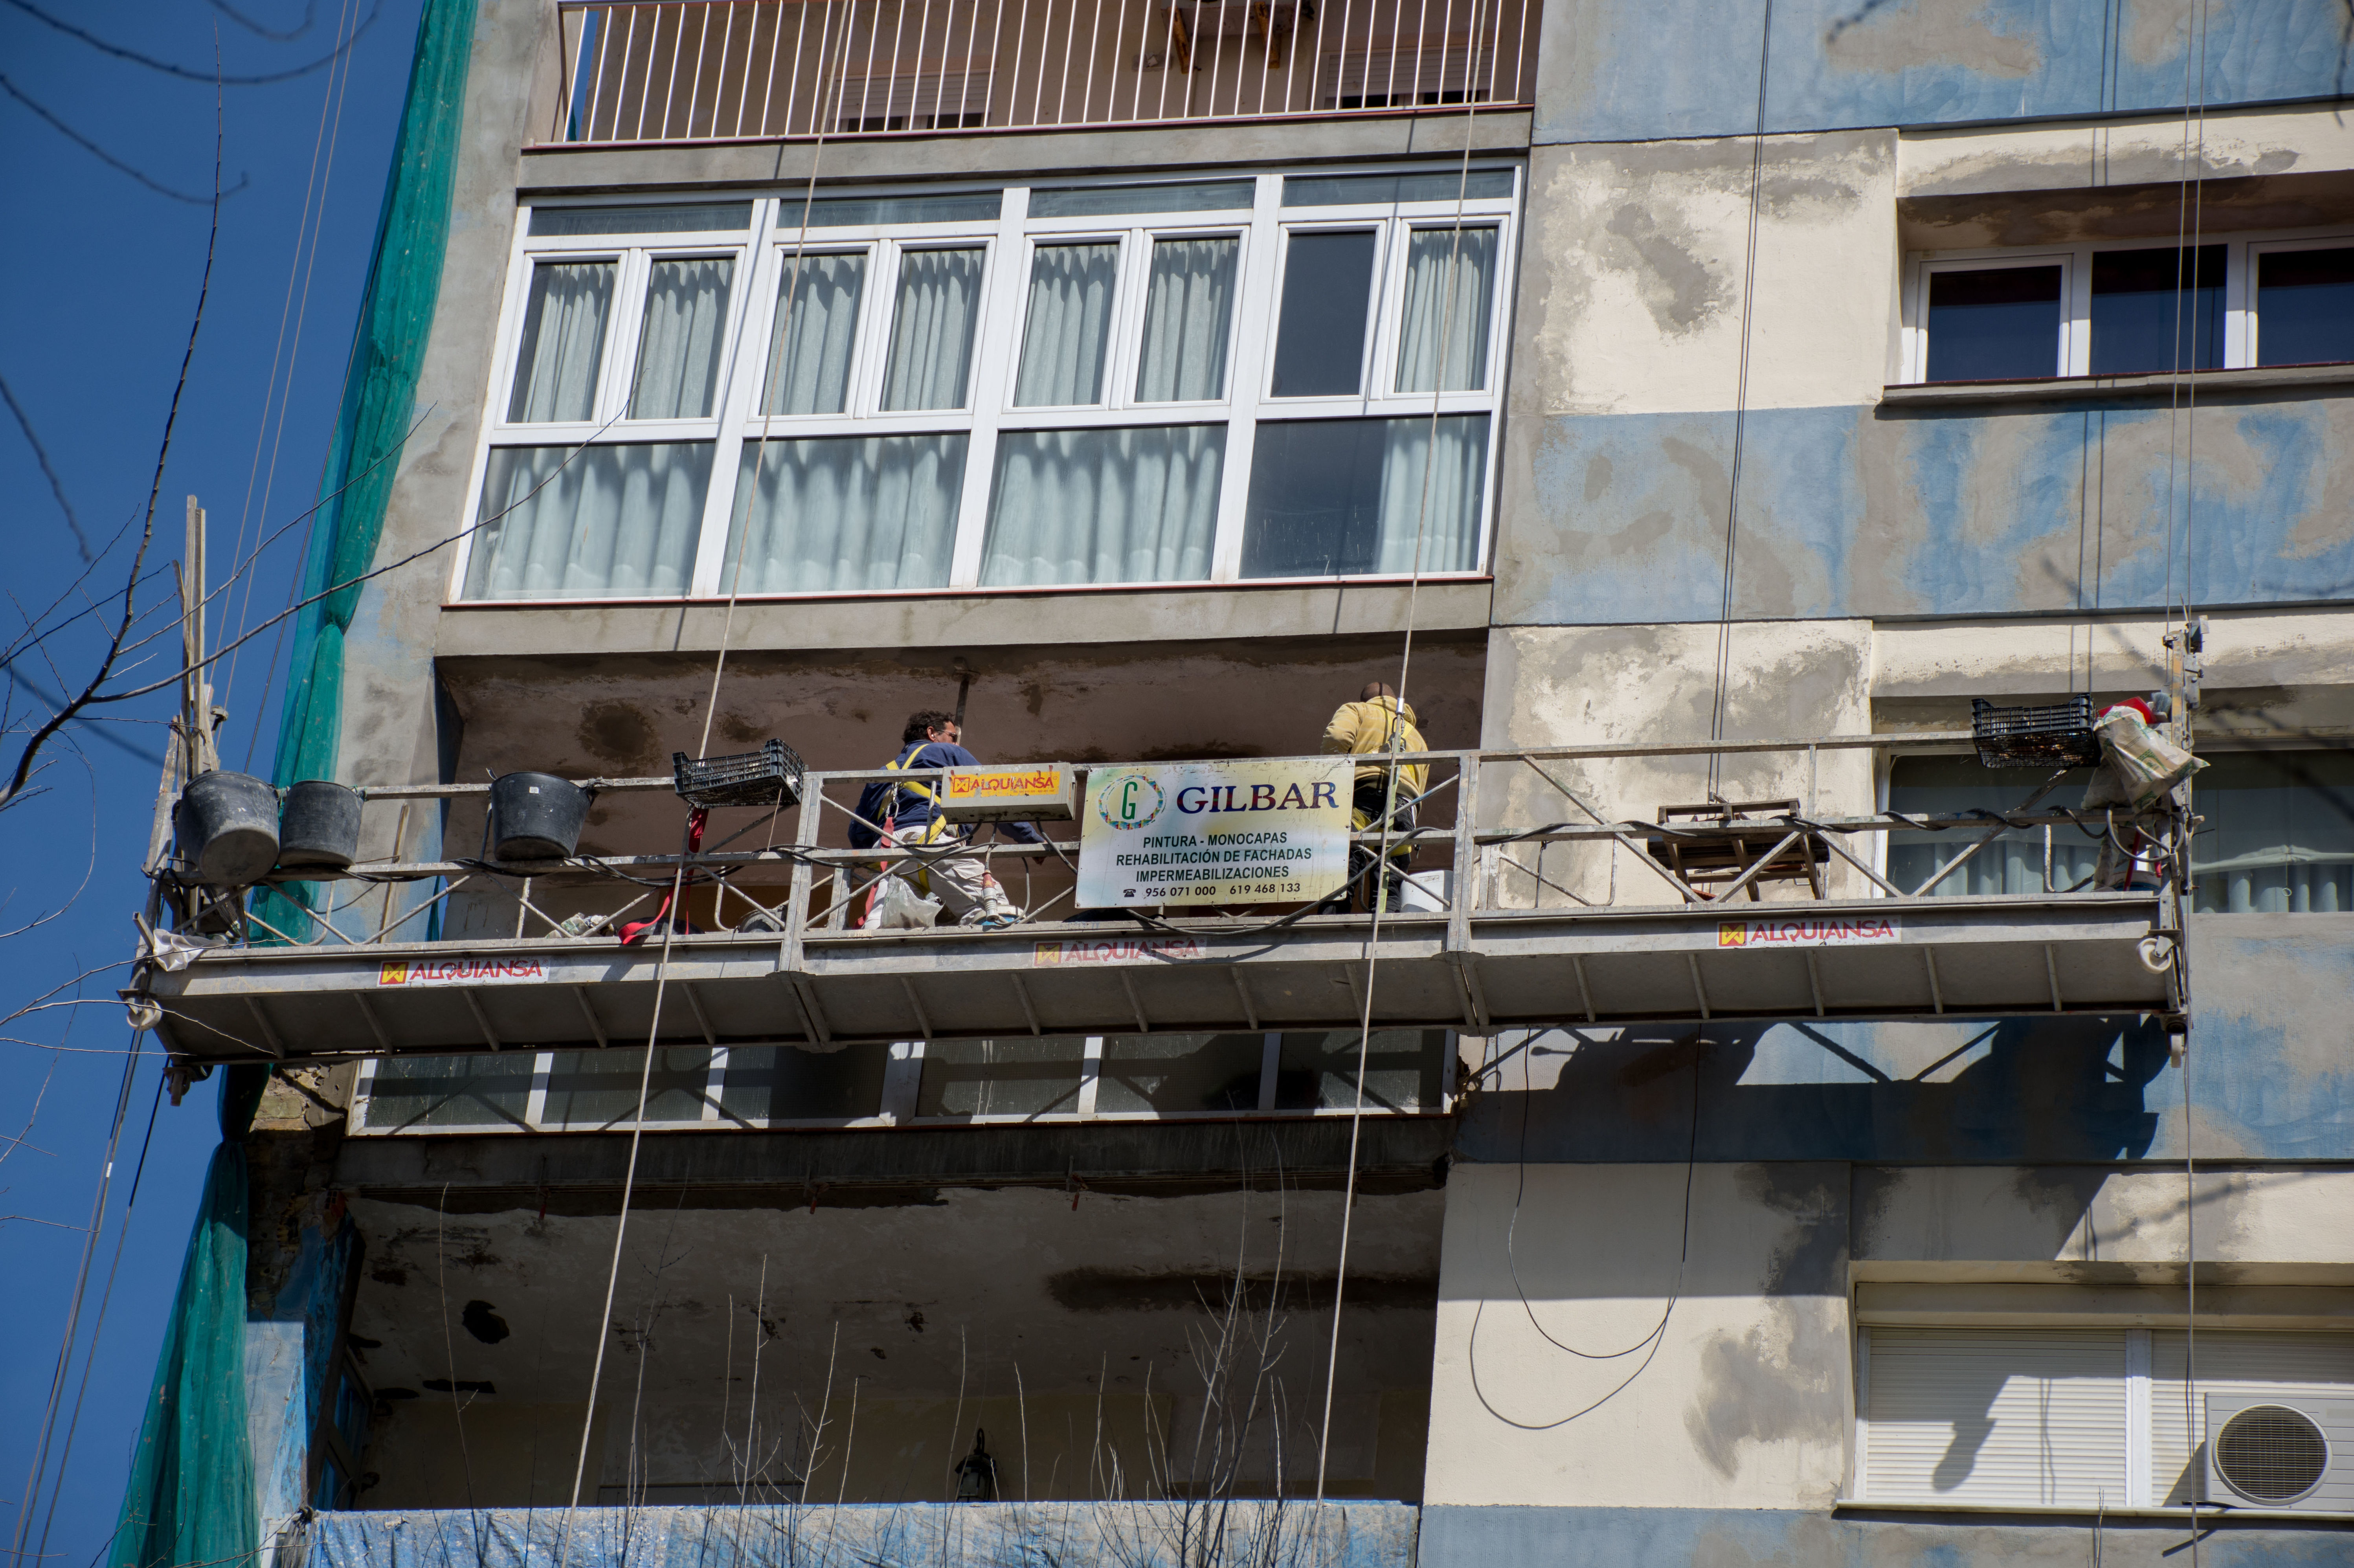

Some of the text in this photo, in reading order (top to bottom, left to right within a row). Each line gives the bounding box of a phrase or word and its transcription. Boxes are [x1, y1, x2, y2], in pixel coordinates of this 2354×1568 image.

[970, 777, 1054, 791] ALQUIANSA
[1122, 781, 1138, 820] G
[1177, 782, 1339, 814] GILBAR
[1143, 835, 1197, 848] PINTURA
[1208, 832, 1287, 846] MONOCAPAS
[1116, 848, 1311, 866] REHABILITACIÓN DE FACHADAS
[1136, 866, 1289, 882] IMPERMEABILIZACIONES
[1146, 883, 1300, 897] 956 071 000 619 468 133
[1751, 920, 1894, 942] ALQUIANSA
[1065, 940, 1199, 962] ALQUIANSA
[409, 959, 542, 980] ALQUIANSA
